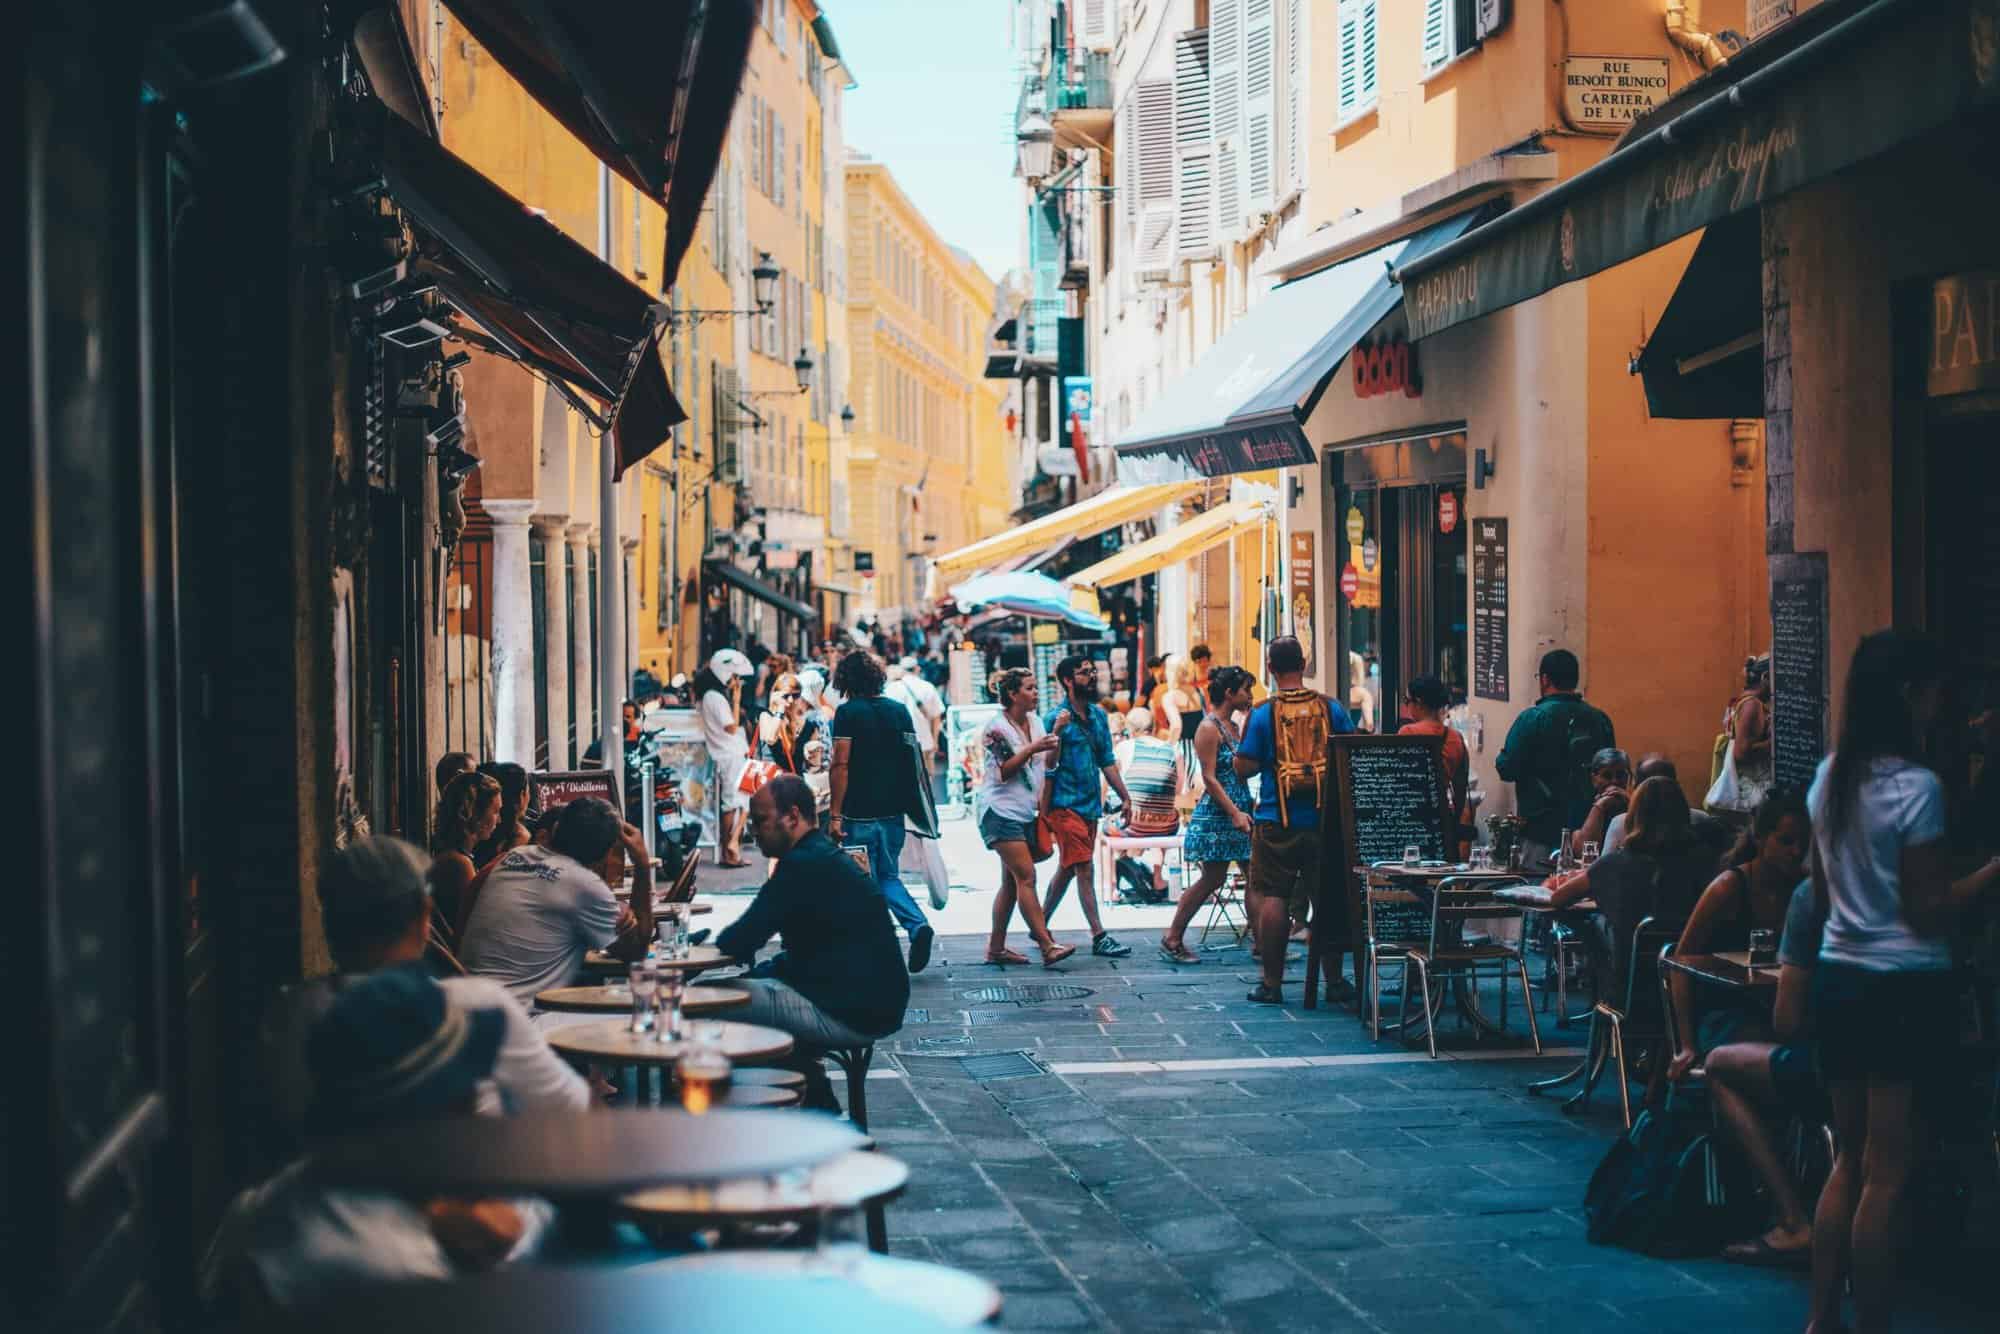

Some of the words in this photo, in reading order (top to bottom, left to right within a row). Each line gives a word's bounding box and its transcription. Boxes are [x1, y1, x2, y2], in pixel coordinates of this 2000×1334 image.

[1603, 62, 1631, 73] RUE
[1567, 74, 1613, 86] BENOÎT
[1617, 76, 1666, 88] BUNICO
[1581, 93, 1653, 106] CARRIERA
[1584, 107, 1602, 118] DE
[1416, 258, 1480, 321] PAPAYOU
